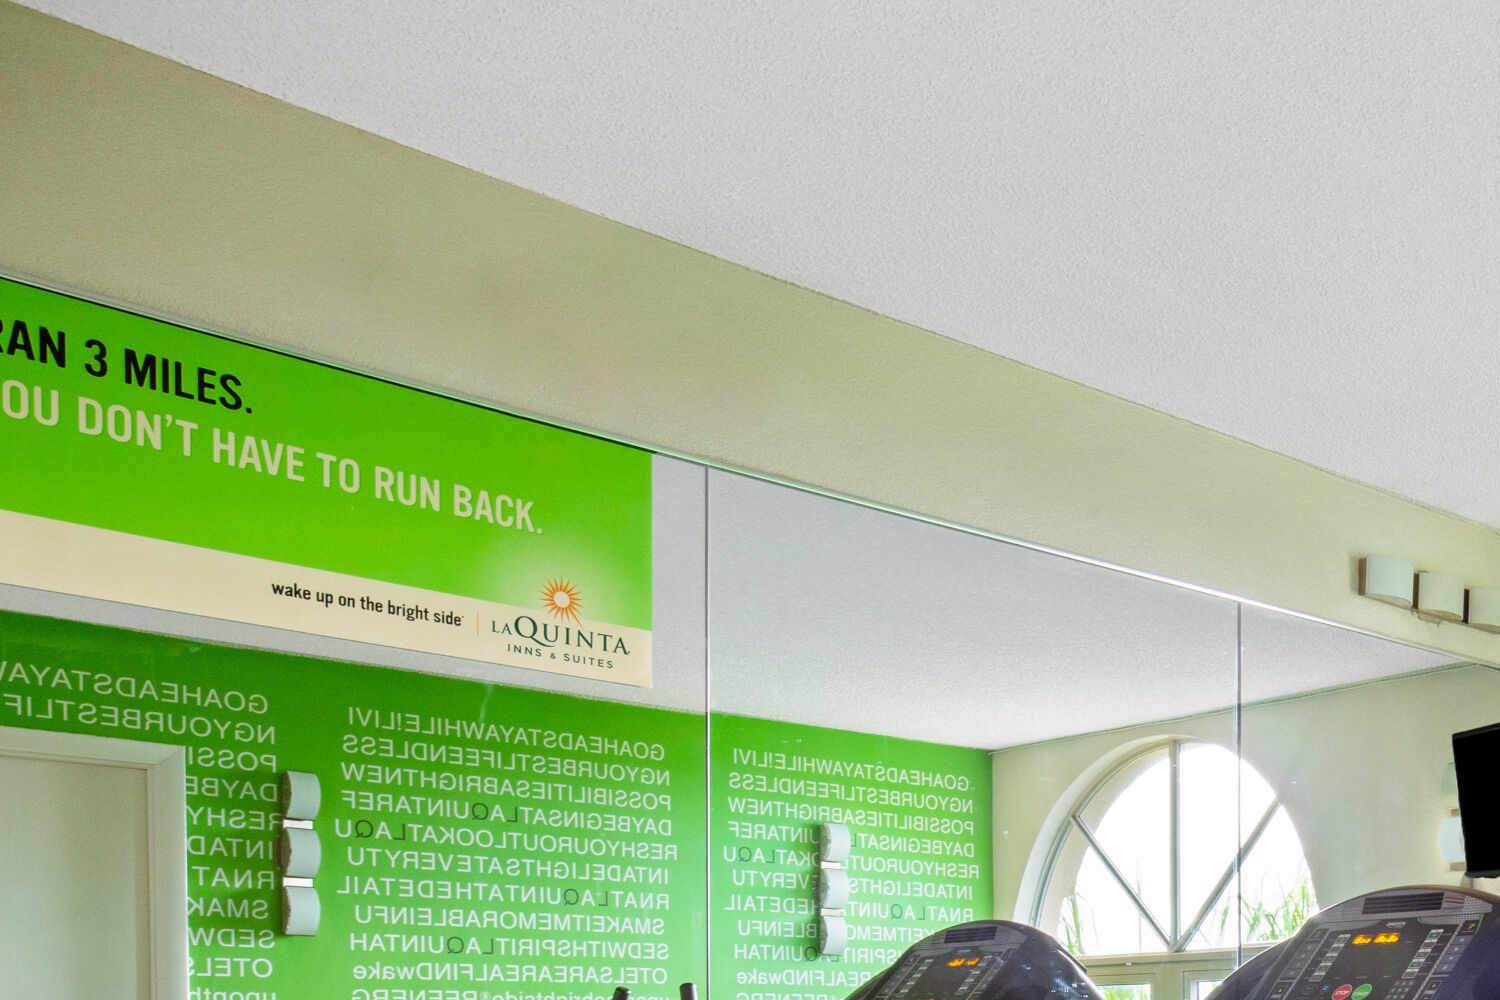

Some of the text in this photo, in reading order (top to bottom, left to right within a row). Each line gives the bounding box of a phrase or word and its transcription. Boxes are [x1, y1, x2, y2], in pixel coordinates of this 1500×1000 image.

[85, 338, 108, 378] 3
[124, 348, 254, 414] MILES.
[2, 379, 543, 536] OU DON'T HAVE TO RUN BACK.
[271, 582, 462, 628] wake up on the bright side
[507, 643, 614, 670] INNS & SUITES
